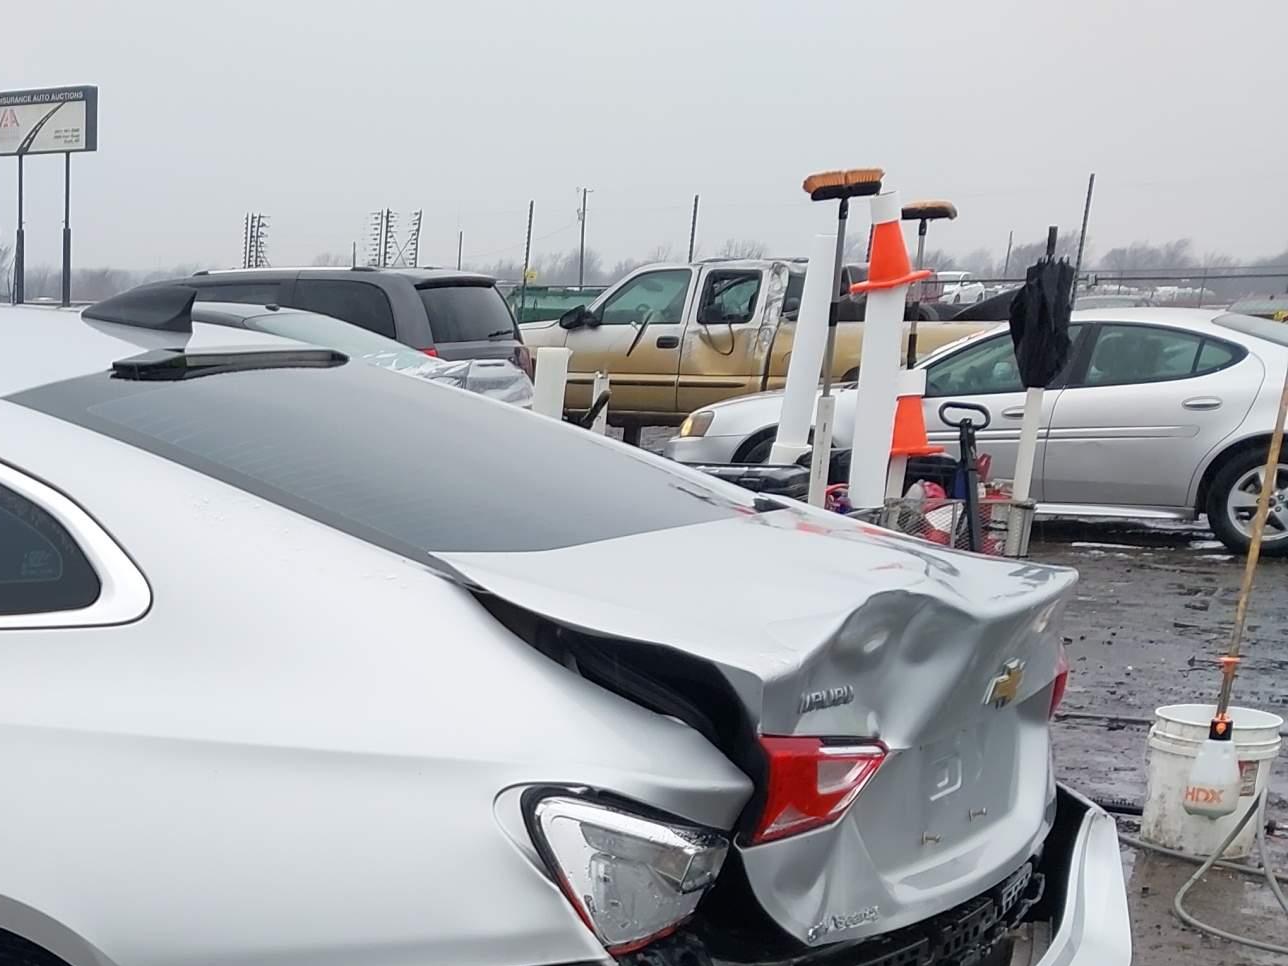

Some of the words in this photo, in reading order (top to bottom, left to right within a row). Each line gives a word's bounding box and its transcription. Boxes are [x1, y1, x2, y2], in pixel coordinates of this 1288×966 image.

[32, 93, 50, 102] AUTO
[50, 91, 84, 101] AUCTIONS
[1184, 786, 1225, 803] HDX
